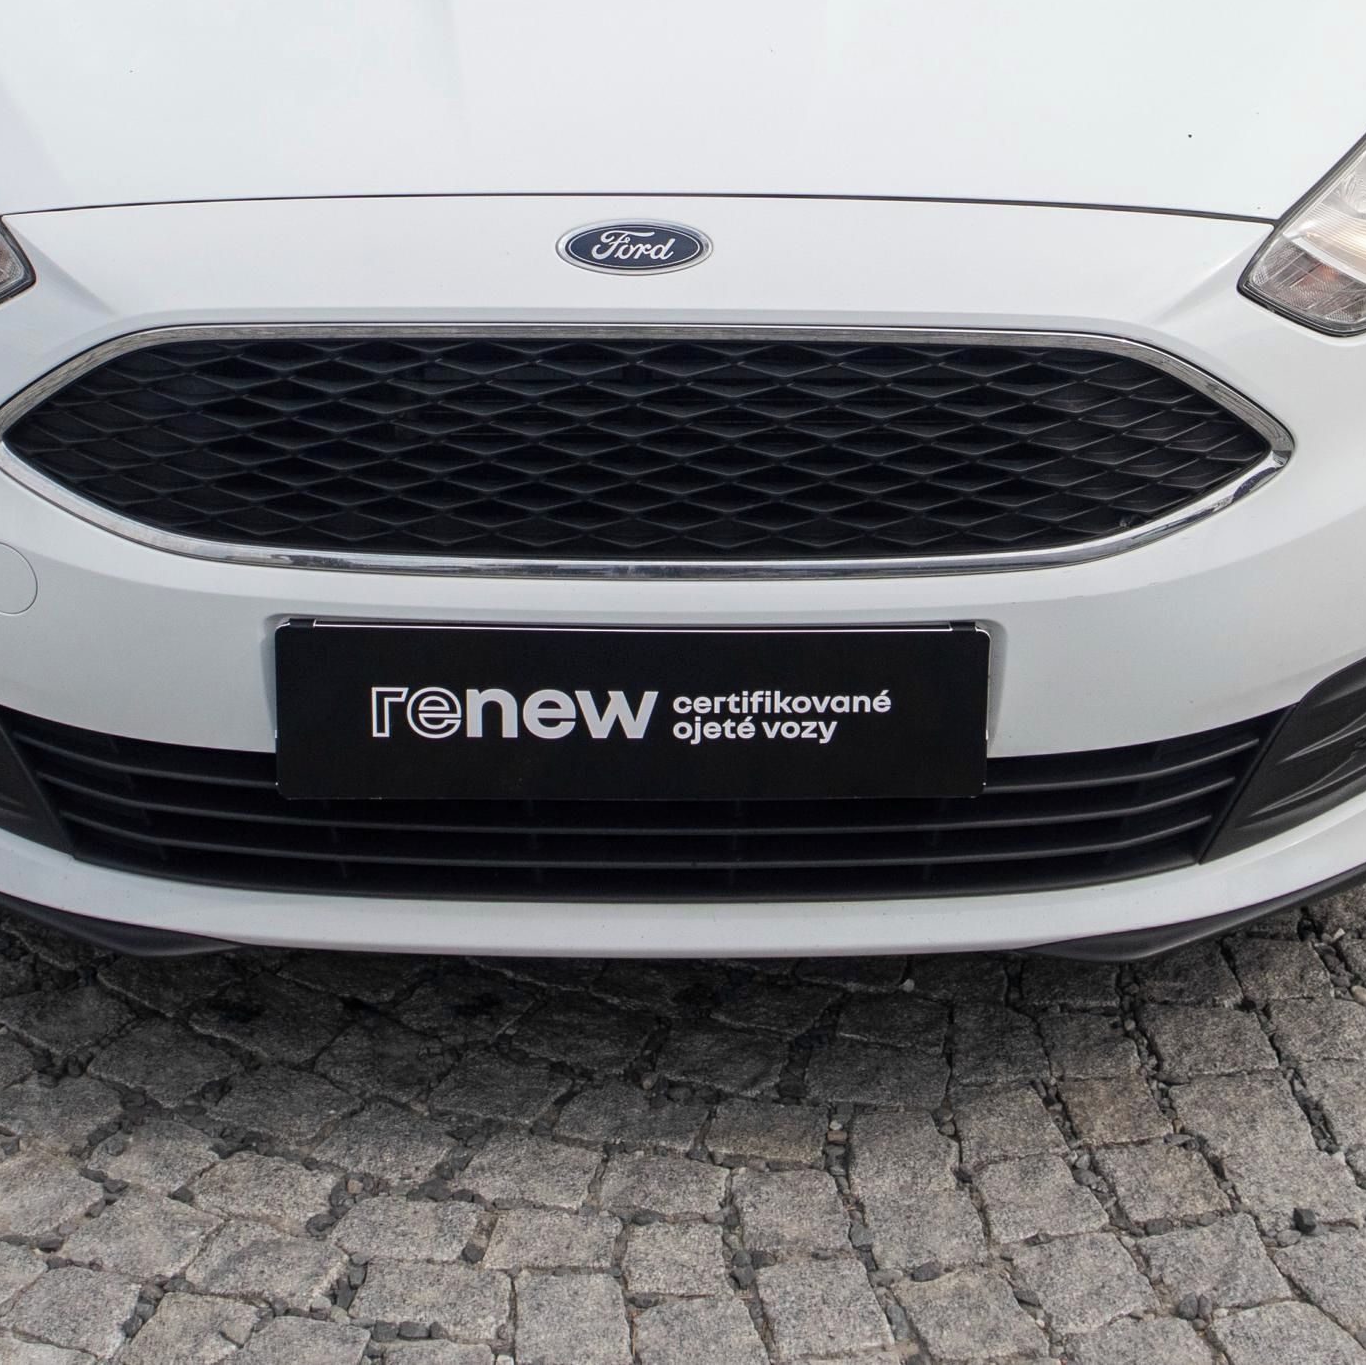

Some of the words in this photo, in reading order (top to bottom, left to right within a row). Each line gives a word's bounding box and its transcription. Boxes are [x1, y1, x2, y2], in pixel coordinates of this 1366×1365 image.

[591, 230, 675, 260] Ford
[371, 686, 659, 739] renew
[672, 689, 892, 715] certifikované
[672, 715, 756, 745] ojeté
[763, 719, 838, 744] vozy
